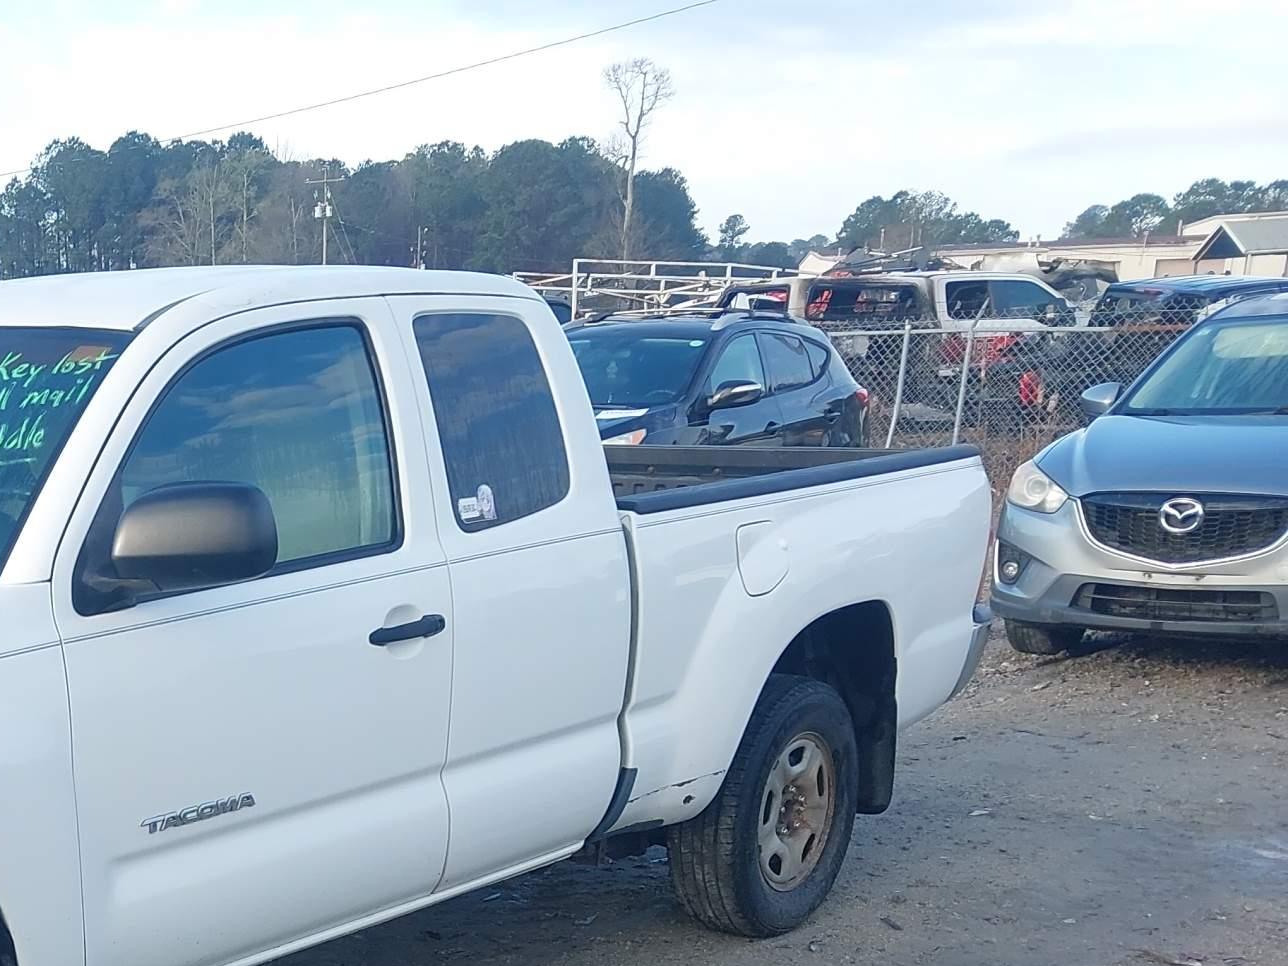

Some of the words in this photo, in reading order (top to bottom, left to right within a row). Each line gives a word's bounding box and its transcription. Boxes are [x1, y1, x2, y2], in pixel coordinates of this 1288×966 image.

[51, 349, 119, 375] lost
[19, 374, 94, 408] mail
[140, 791, 256, 834] TACOMA
